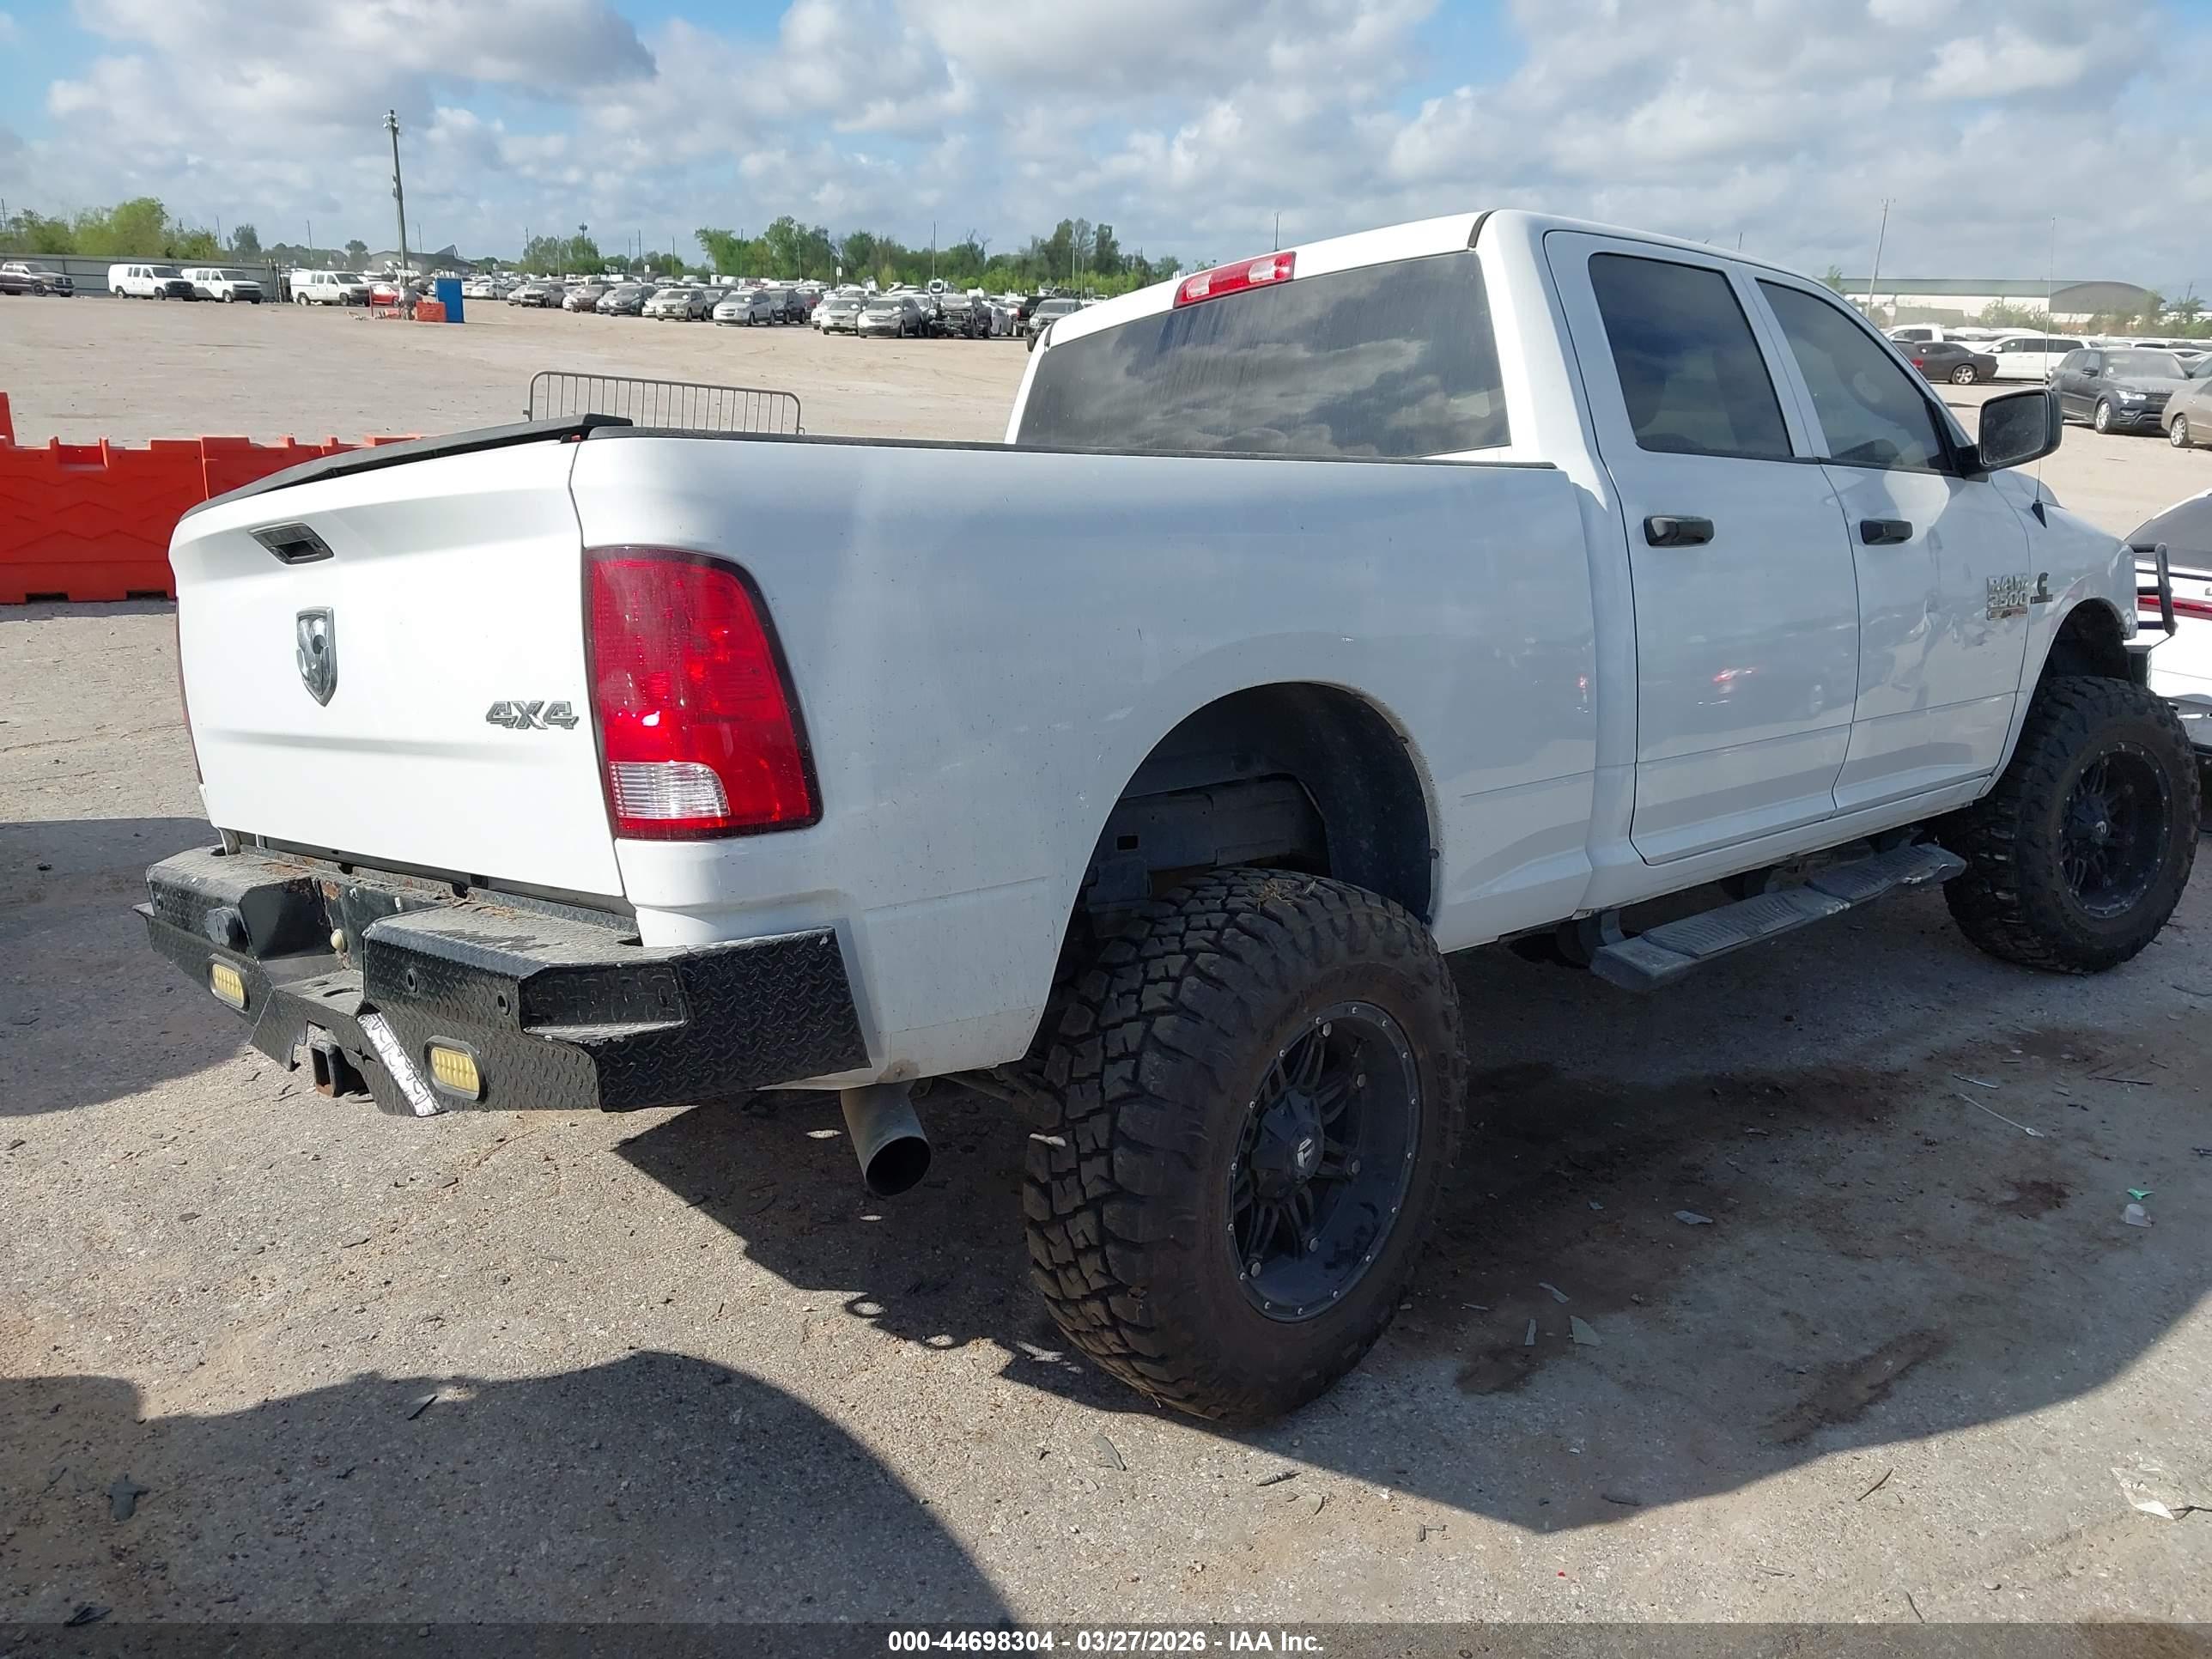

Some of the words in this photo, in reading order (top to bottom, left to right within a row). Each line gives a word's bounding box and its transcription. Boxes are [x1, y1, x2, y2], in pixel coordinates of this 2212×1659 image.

[1987, 574, 2027, 591] RAM
[1987, 591, 2027, 607] 2500
[486, 700, 580, 730] 4X4
